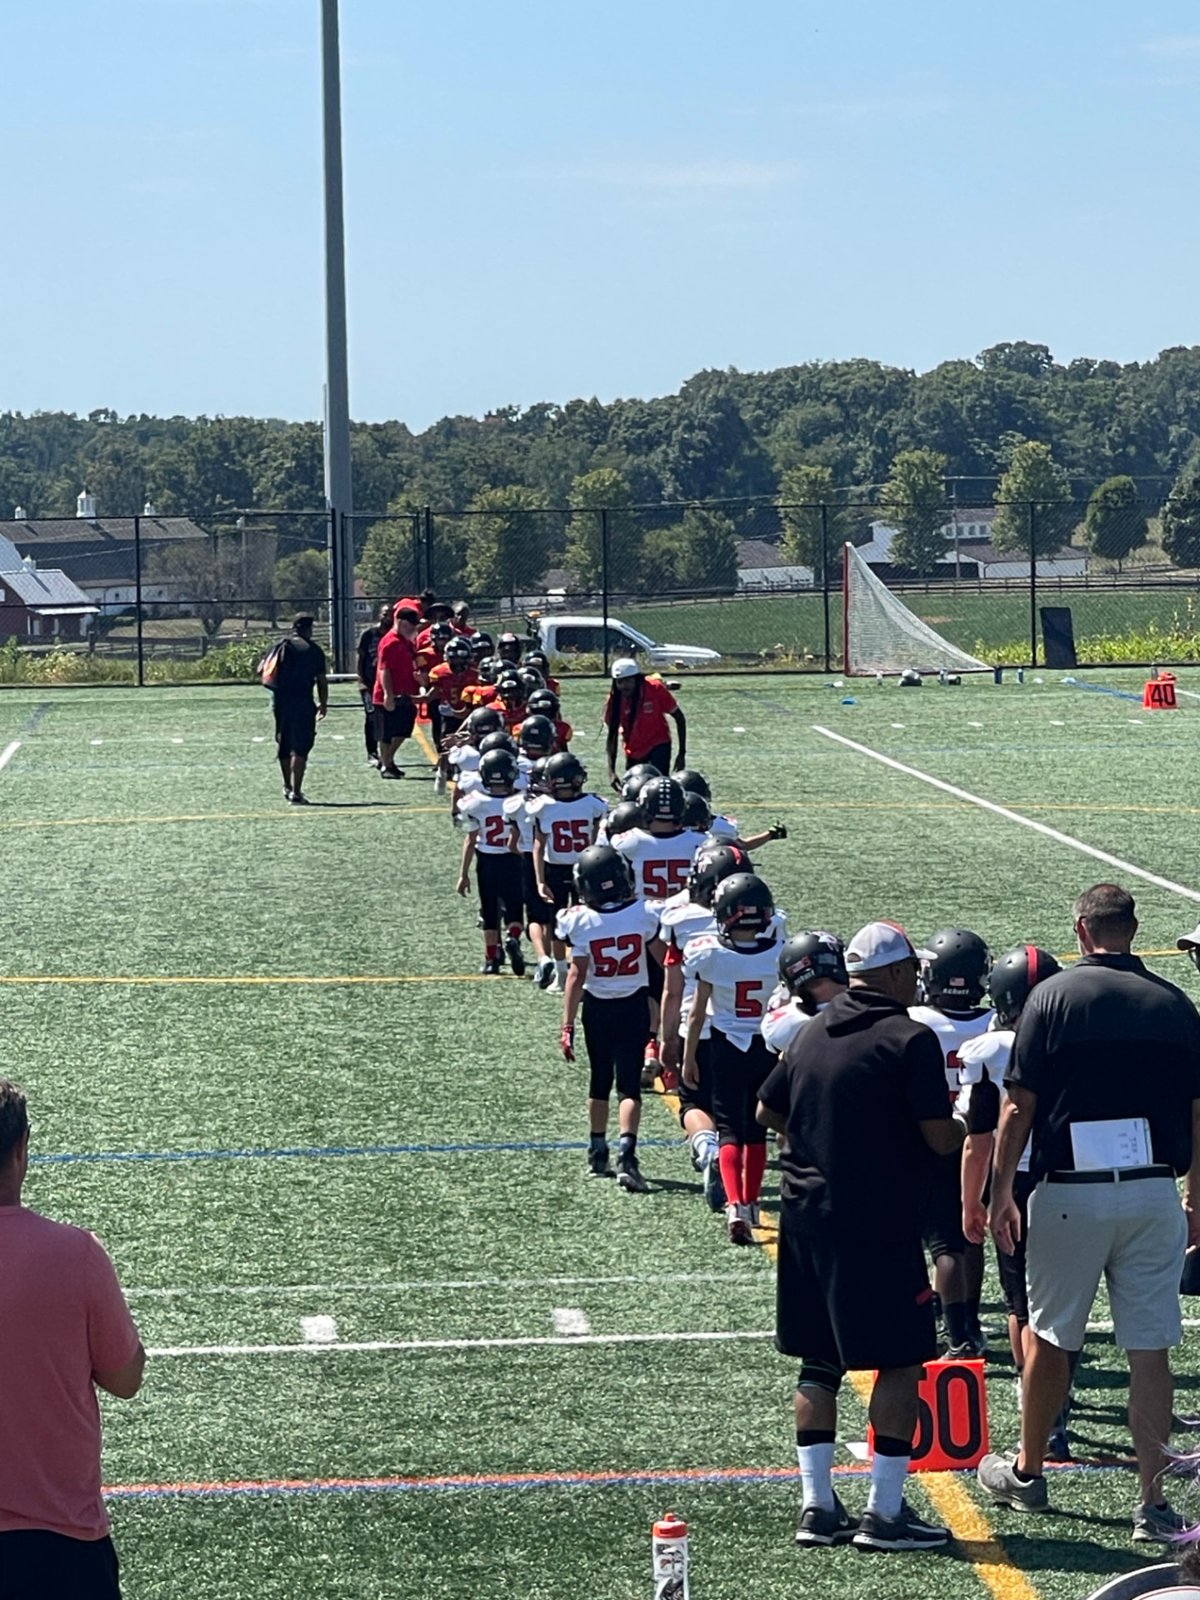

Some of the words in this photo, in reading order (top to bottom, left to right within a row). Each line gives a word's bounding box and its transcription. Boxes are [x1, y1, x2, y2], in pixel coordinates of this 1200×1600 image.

[1151, 684, 1176, 706] 40
[485, 815, 509, 847] 2
[552, 820, 591, 853] 65
[643, 859, 691, 898] 55
[590, 933, 643, 978] 52
[735, 981, 762, 1018] 5
